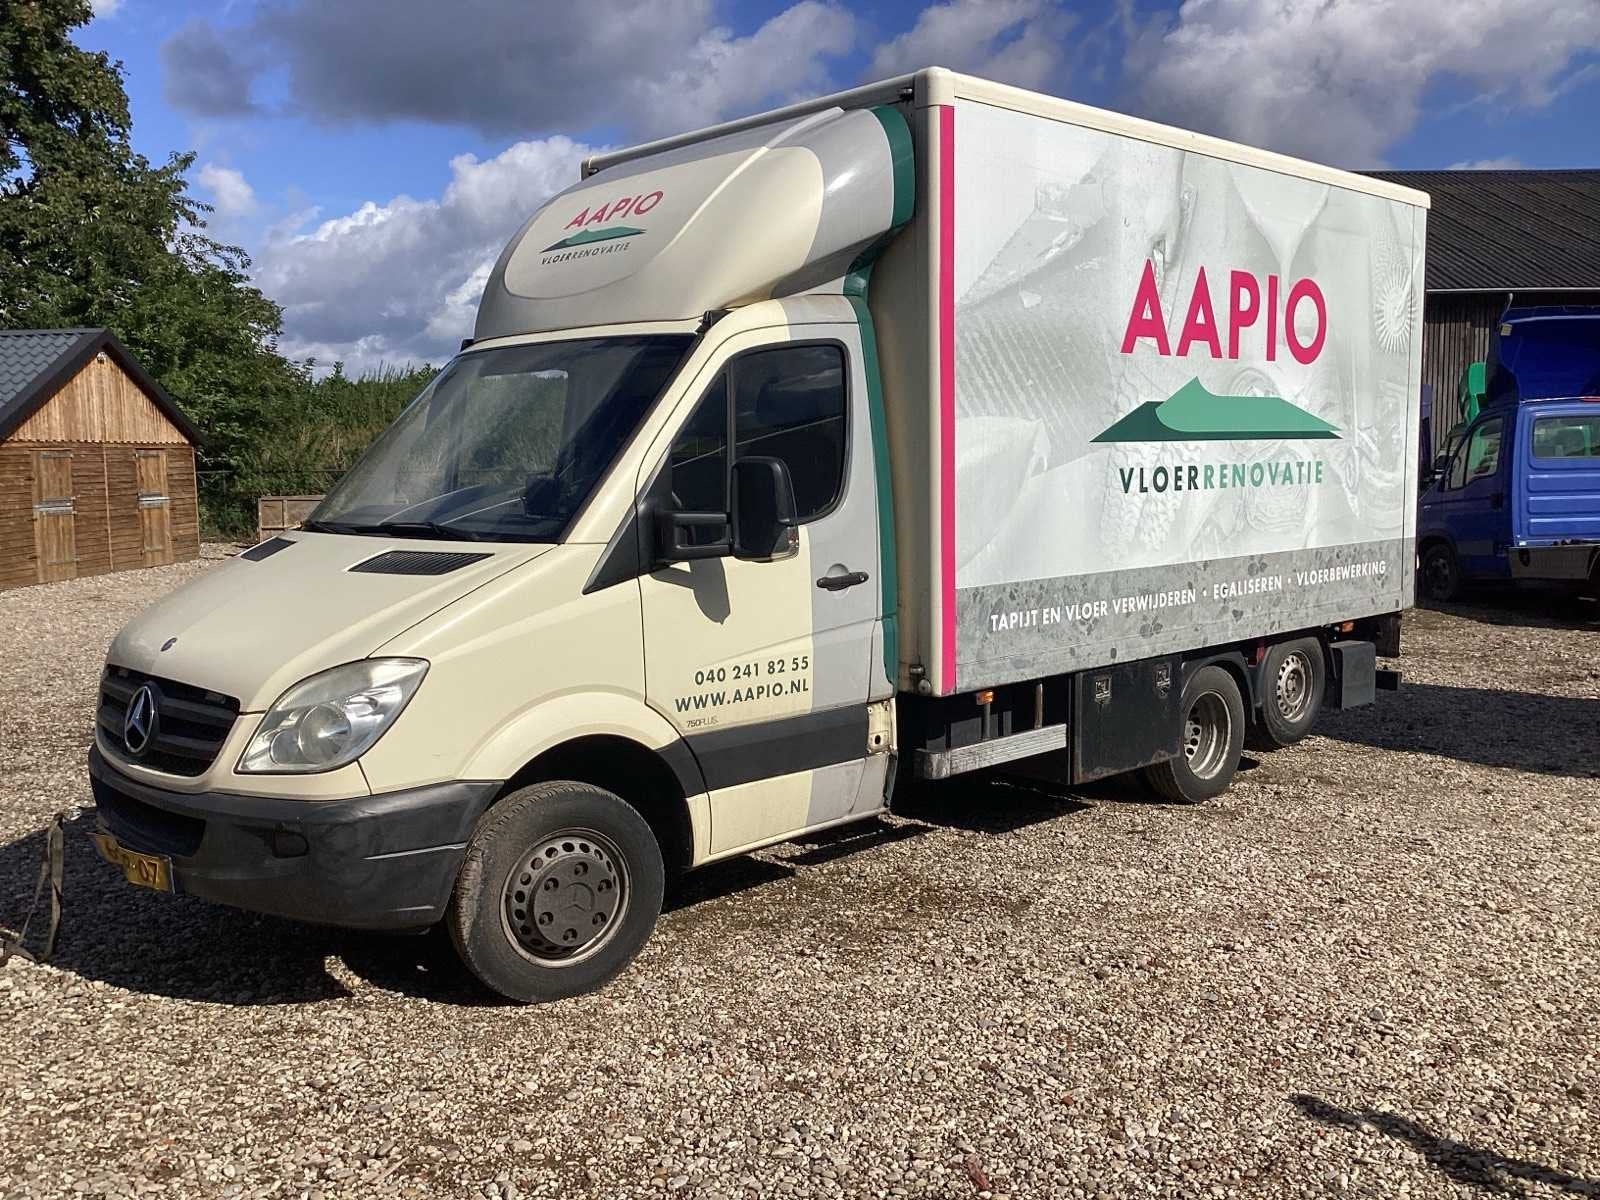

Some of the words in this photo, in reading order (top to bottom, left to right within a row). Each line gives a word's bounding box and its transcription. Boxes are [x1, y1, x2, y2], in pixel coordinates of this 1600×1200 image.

[564, 191, 664, 230] AAPIO
[542, 242, 631, 265] VLOERRENOVATIE
[1120, 258, 1328, 365] AAPIO
[1119, 460, 1323, 494] VLOERRENOVATIE
[991, 609, 1039, 632] TAPIJT
[1042, 607, 1061, 625] EN
[1065, 600, 1108, 622] VLOER
[1112, 588, 1196, 615] VERWIJDEREN
[1213, 575, 1282, 600] EGALISEREN
[1297, 560, 1387, 587] VLOERBEWERKING
[694, 667, 726, 686] 040
[732, 663, 759, 680] 241
[767, 659, 785, 675] 82
[791, 656, 809, 672] 55
[674, 678, 809, 713] WWW.AAPIO.NL
